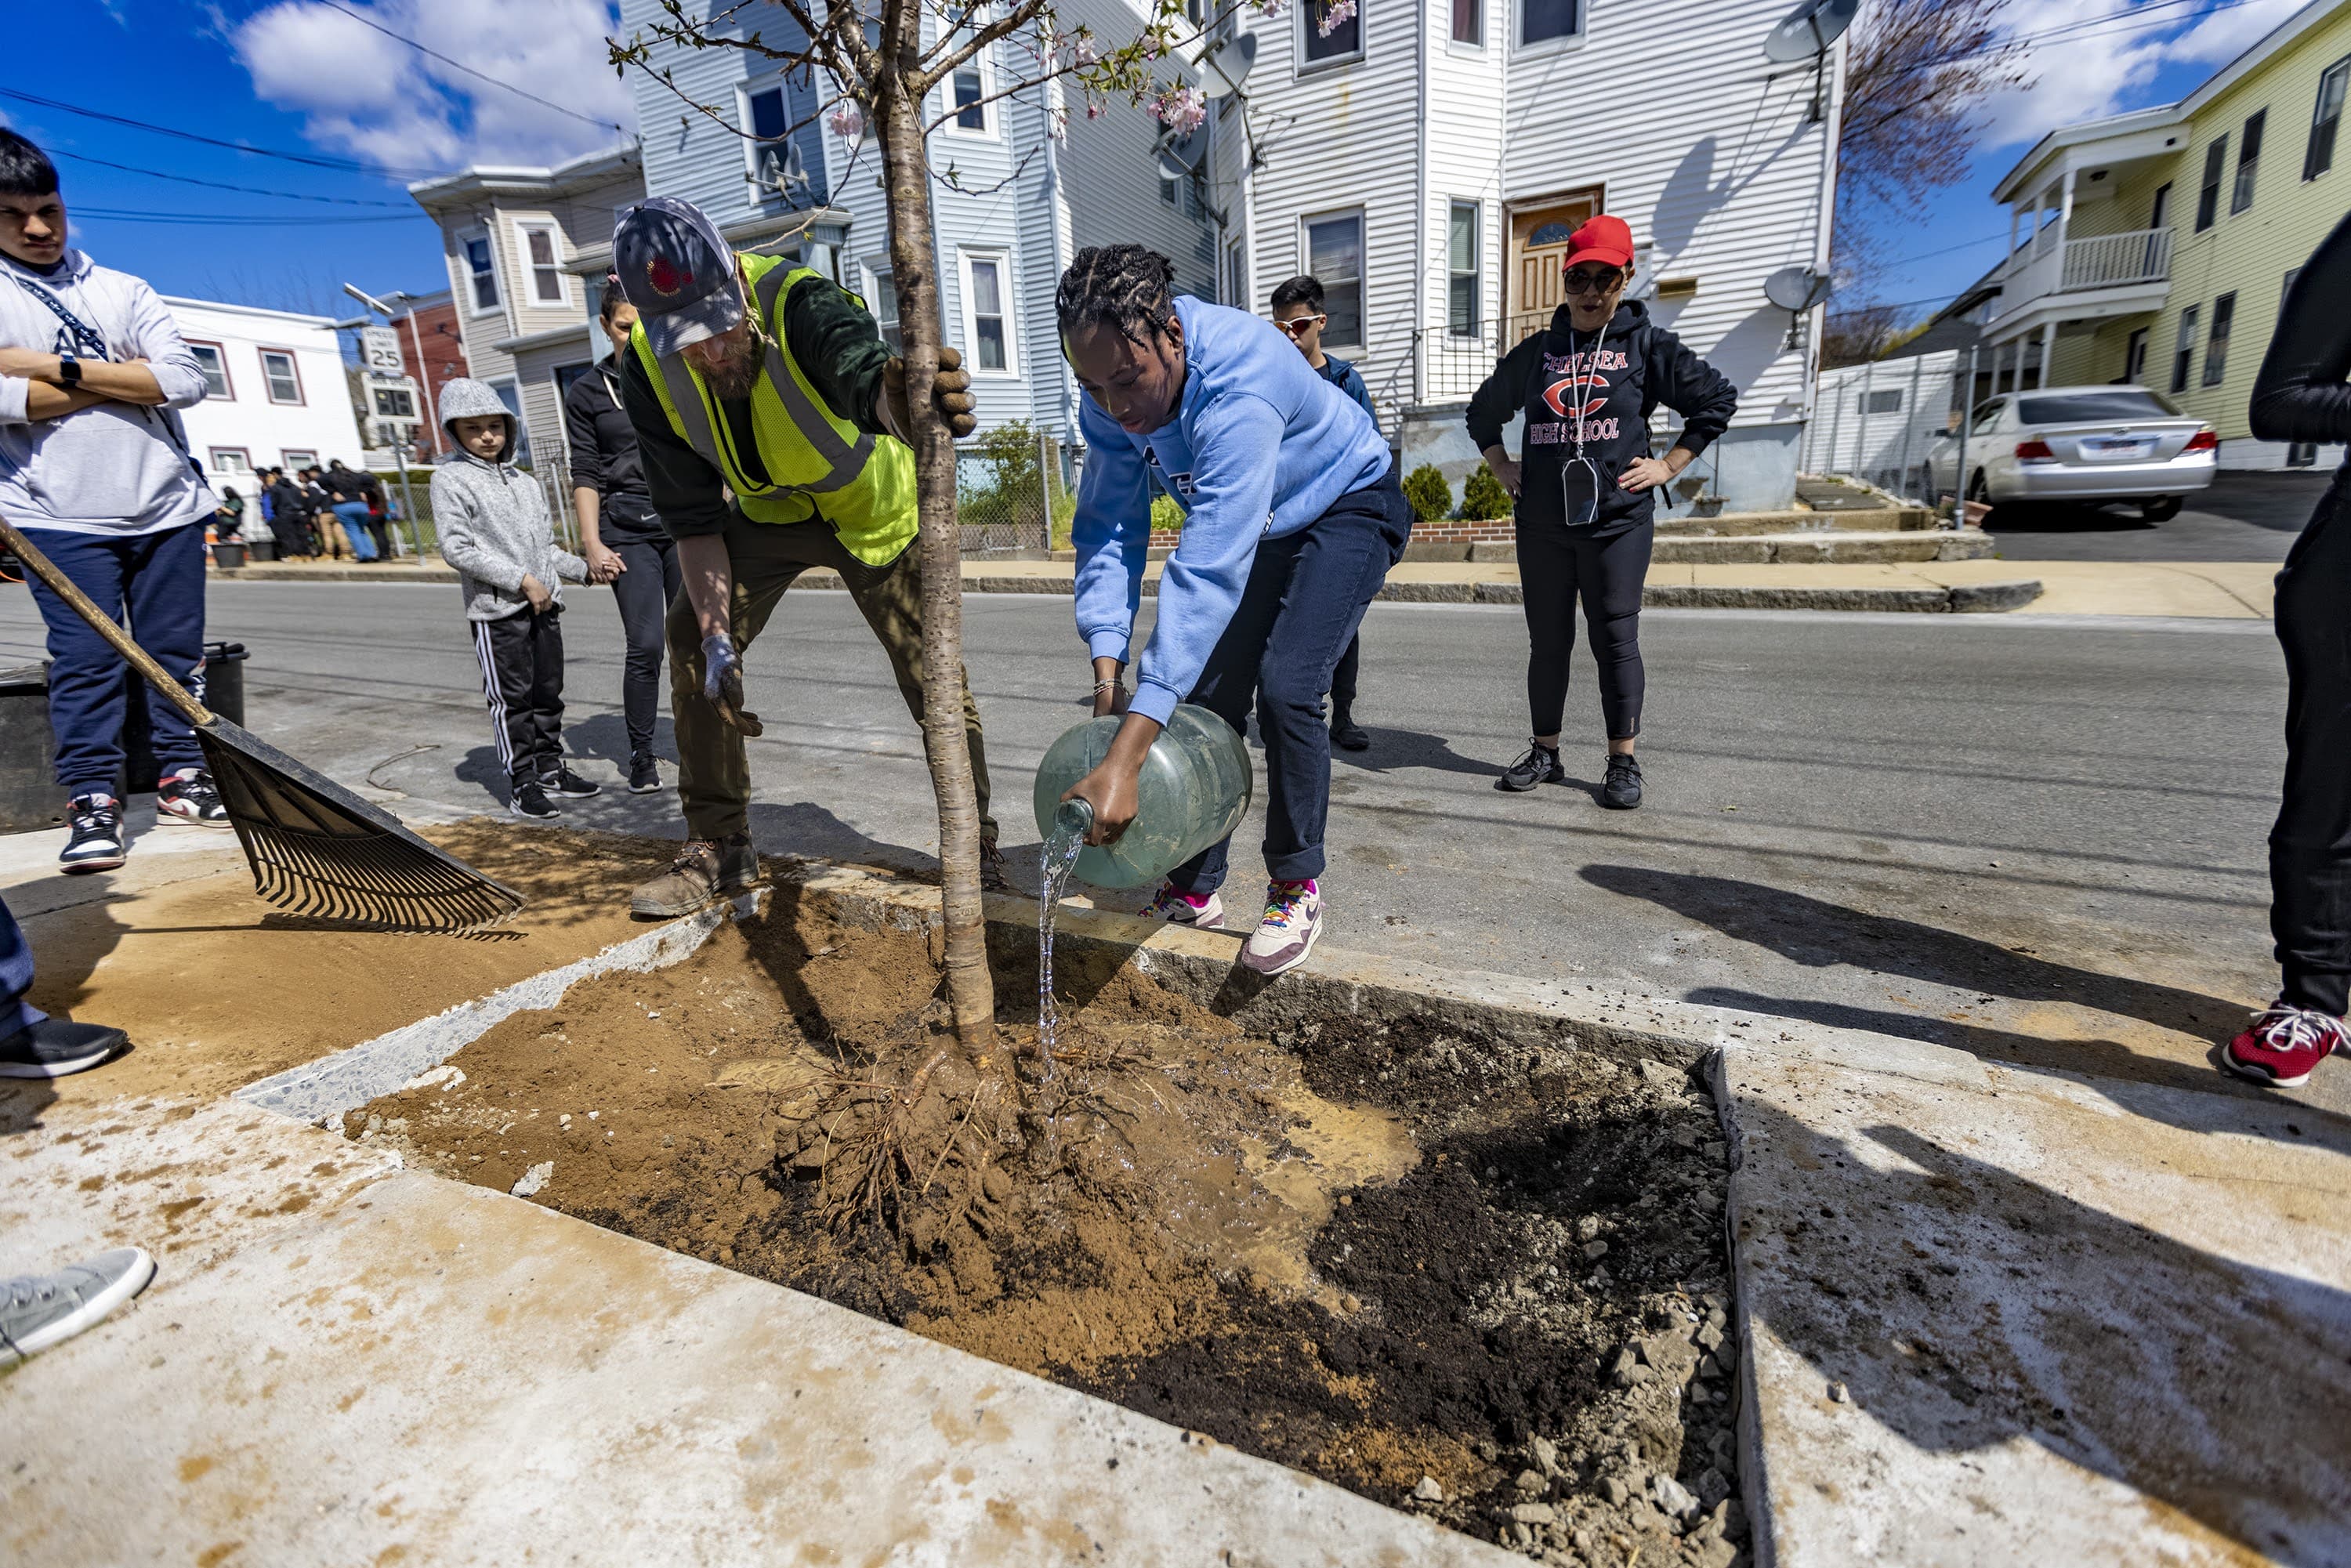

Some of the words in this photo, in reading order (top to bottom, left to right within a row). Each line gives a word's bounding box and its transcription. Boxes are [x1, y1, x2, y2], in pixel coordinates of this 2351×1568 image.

[366, 330, 393, 339] SPEED
[371, 349, 399, 367] 25
[1543, 349, 1628, 374] CHELSEA
[1541, 374, 1610, 418] C
[1530, 422, 1559, 444] HIGH
[1561, 417, 1620, 444] SCHOOL
